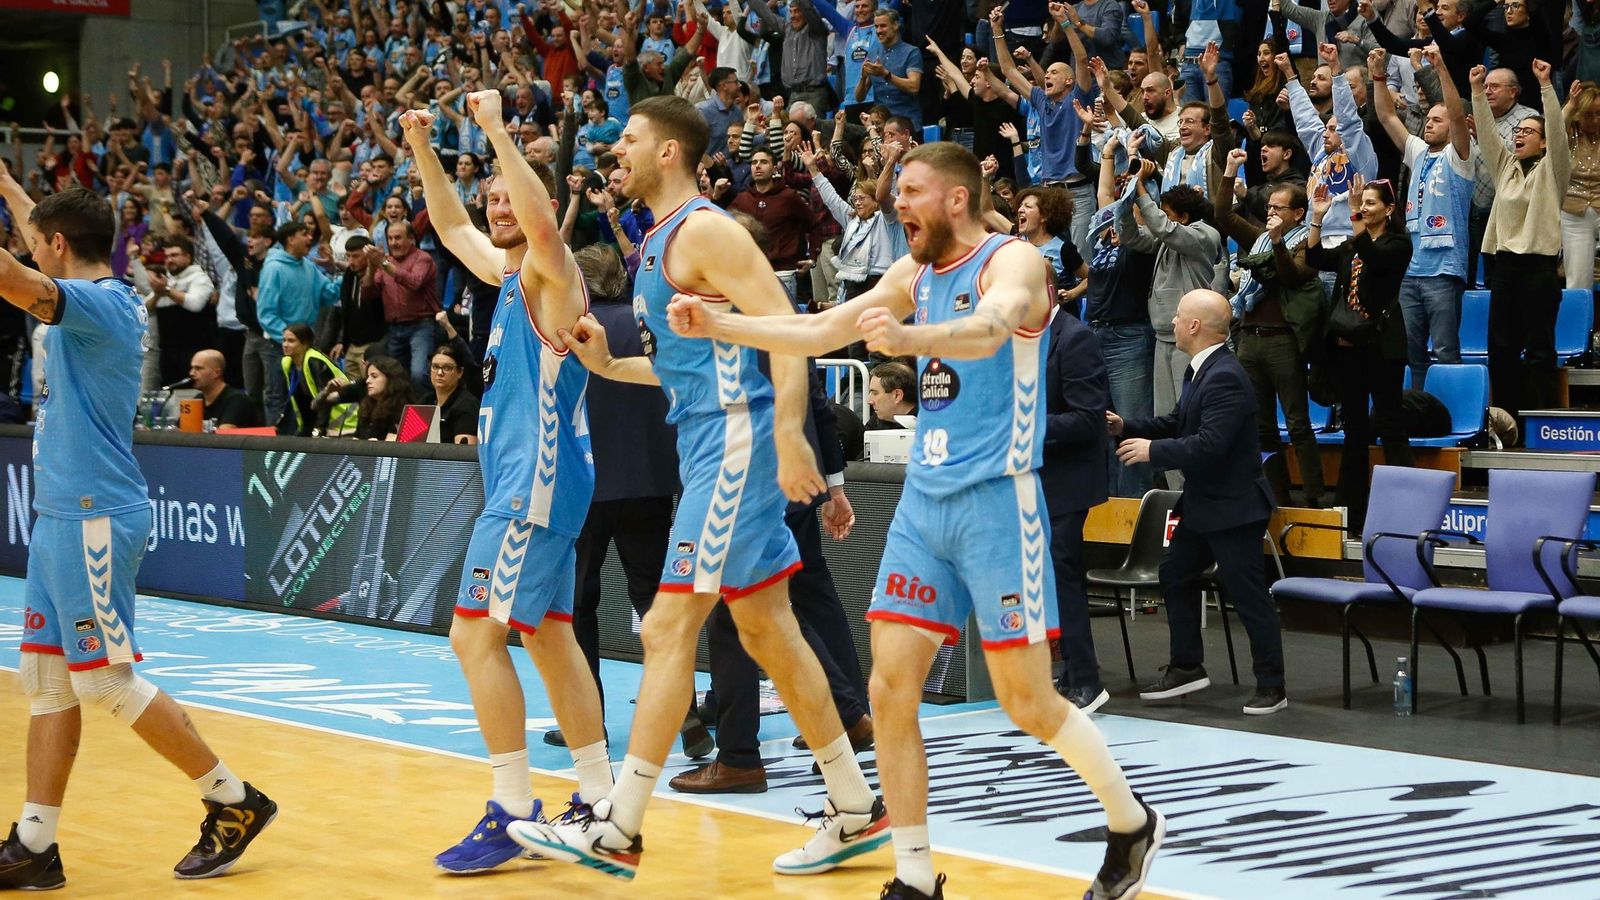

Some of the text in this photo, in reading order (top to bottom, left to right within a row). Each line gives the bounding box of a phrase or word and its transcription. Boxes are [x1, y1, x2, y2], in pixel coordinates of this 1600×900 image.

[1540, 425, 1594, 442] Gestión
[268, 461, 362, 597] LOTUS
[283, 482, 371, 608] CONNECTED
[885, 573, 937, 604] Río
